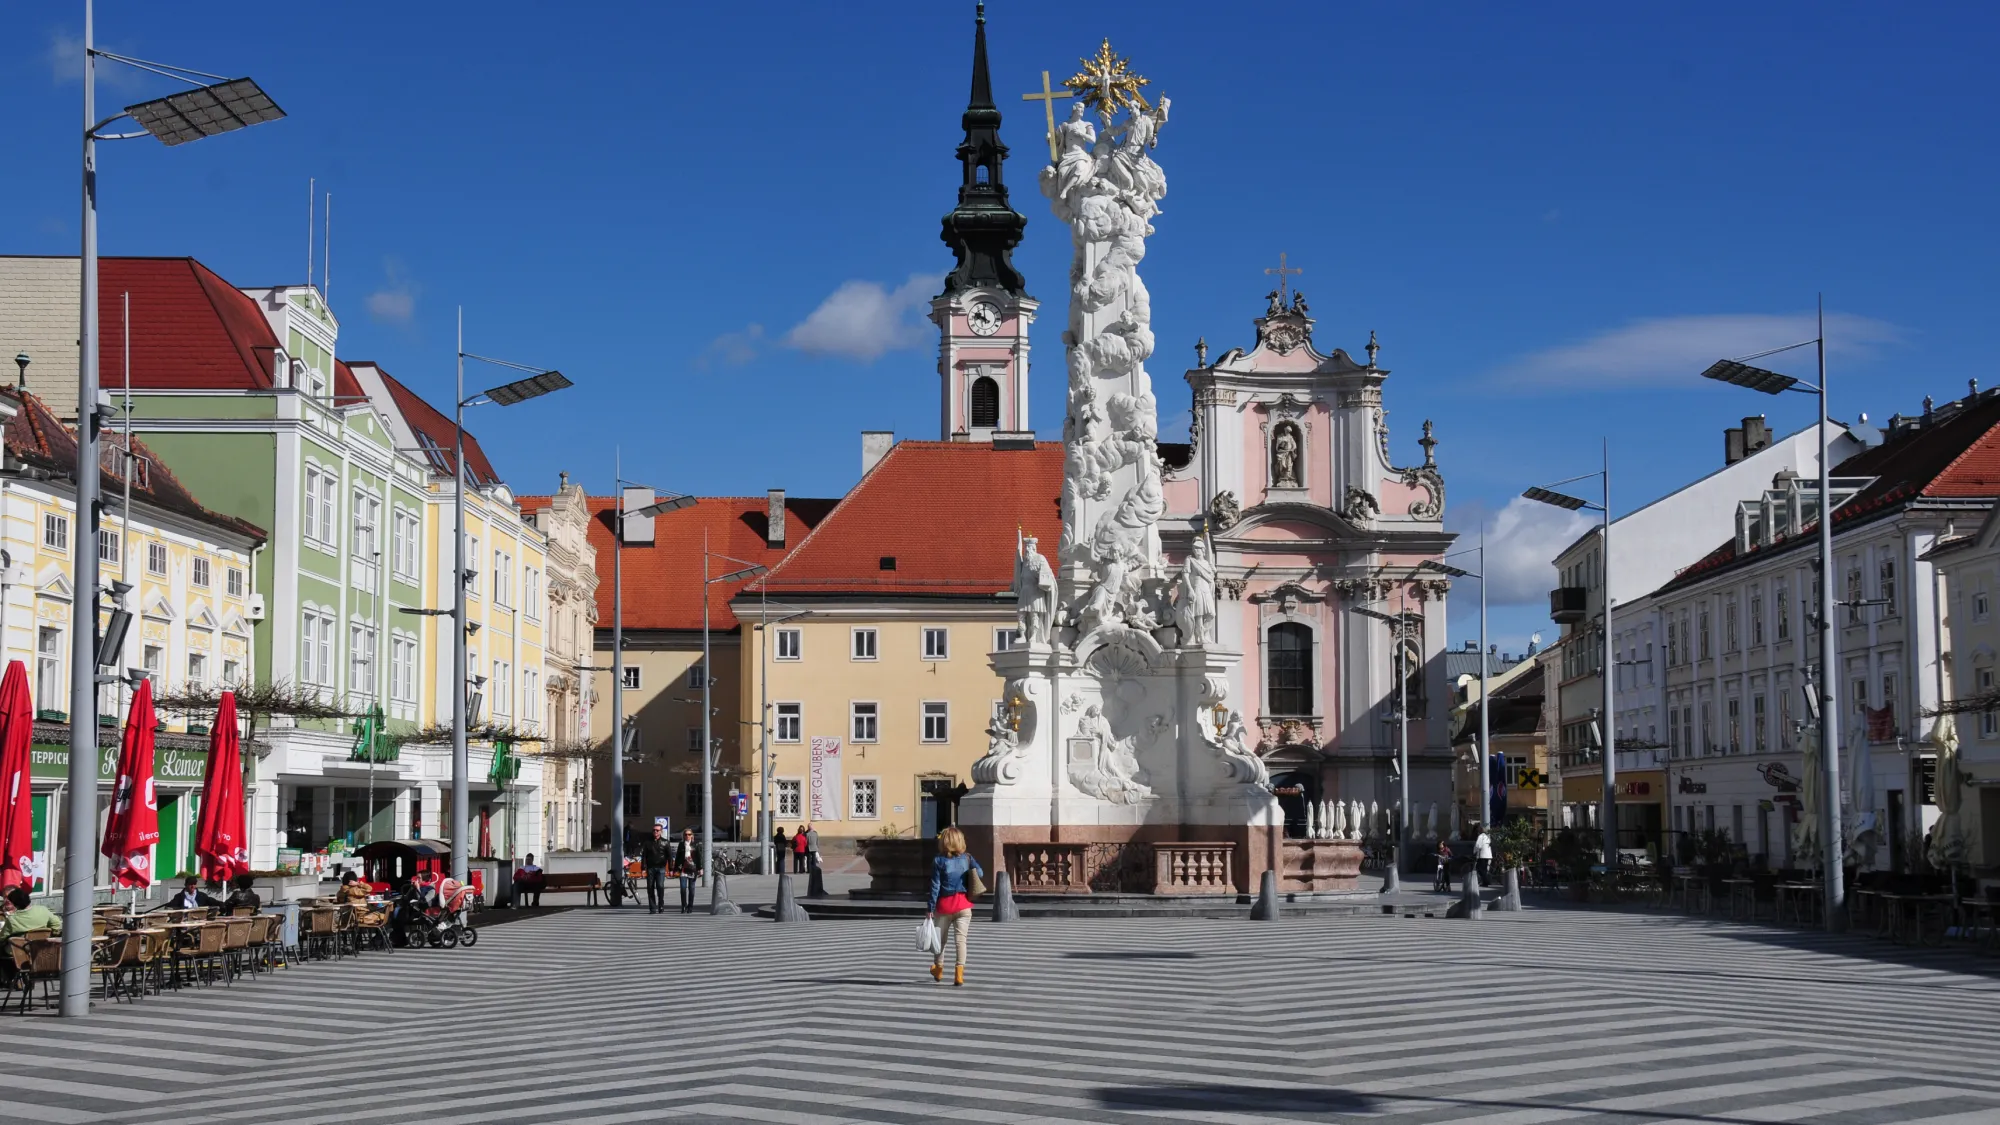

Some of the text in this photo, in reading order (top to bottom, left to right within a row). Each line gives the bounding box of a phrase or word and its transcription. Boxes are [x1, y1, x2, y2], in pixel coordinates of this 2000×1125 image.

[160, 749, 205, 777] Leiner
[812, 738, 823, 788] GLAUBENS
[812, 794, 823, 818] JAHR
